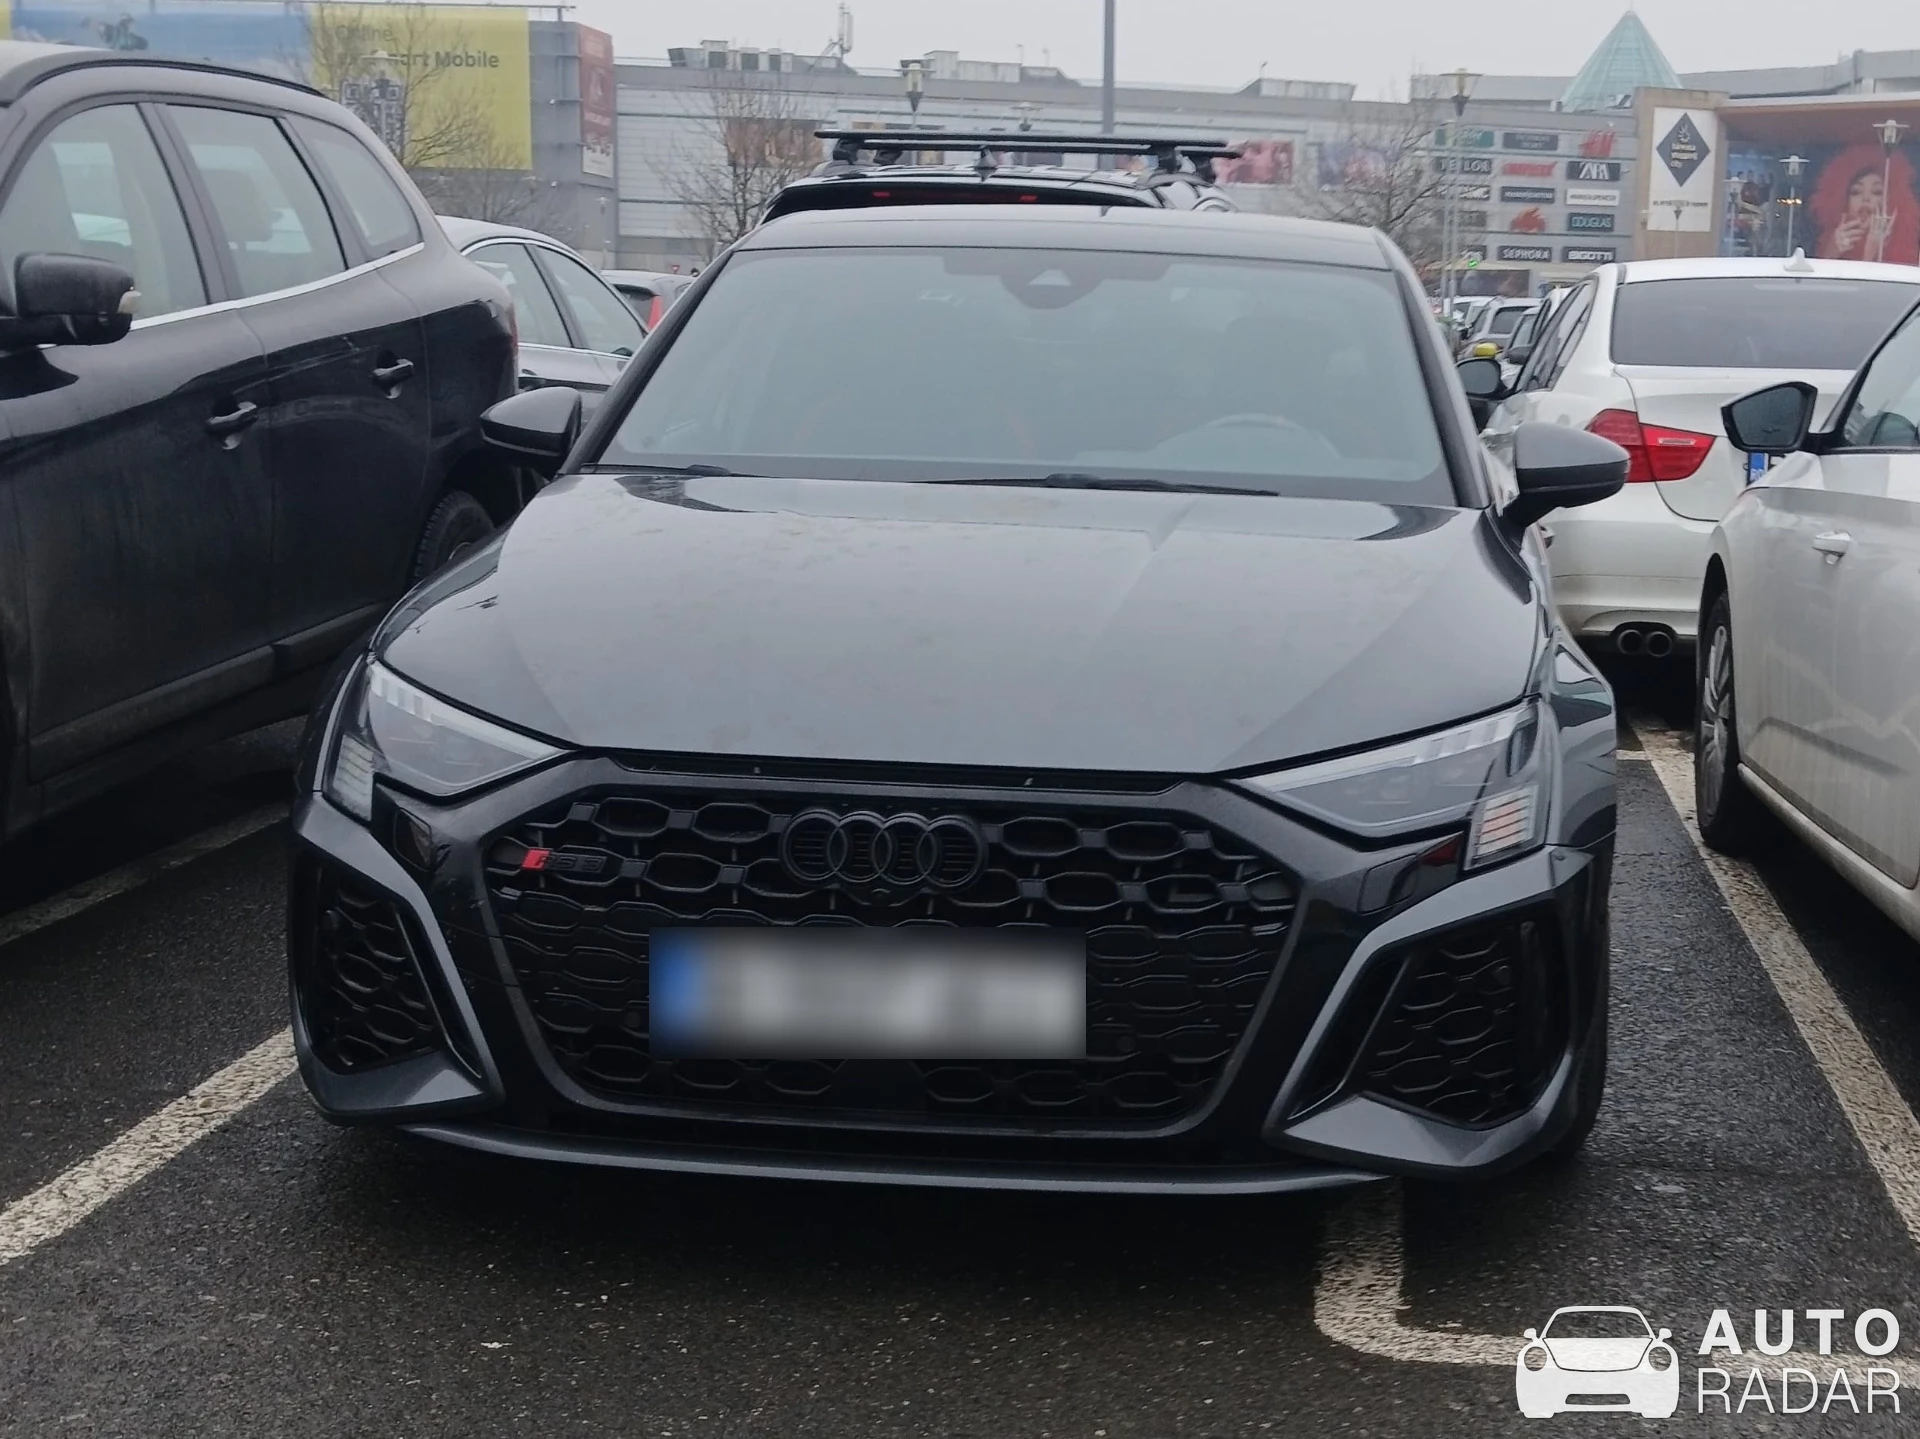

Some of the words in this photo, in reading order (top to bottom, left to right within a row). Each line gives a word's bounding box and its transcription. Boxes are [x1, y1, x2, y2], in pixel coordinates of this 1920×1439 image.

[434, 51, 498, 67] Mobile
[1439, 159, 1489, 173] TELOR
[1571, 215, 1612, 228] DOUGLAS
[1502, 248, 1550, 260] SEPHORA
[1568, 250, 1613, 261] BIGOTTI
